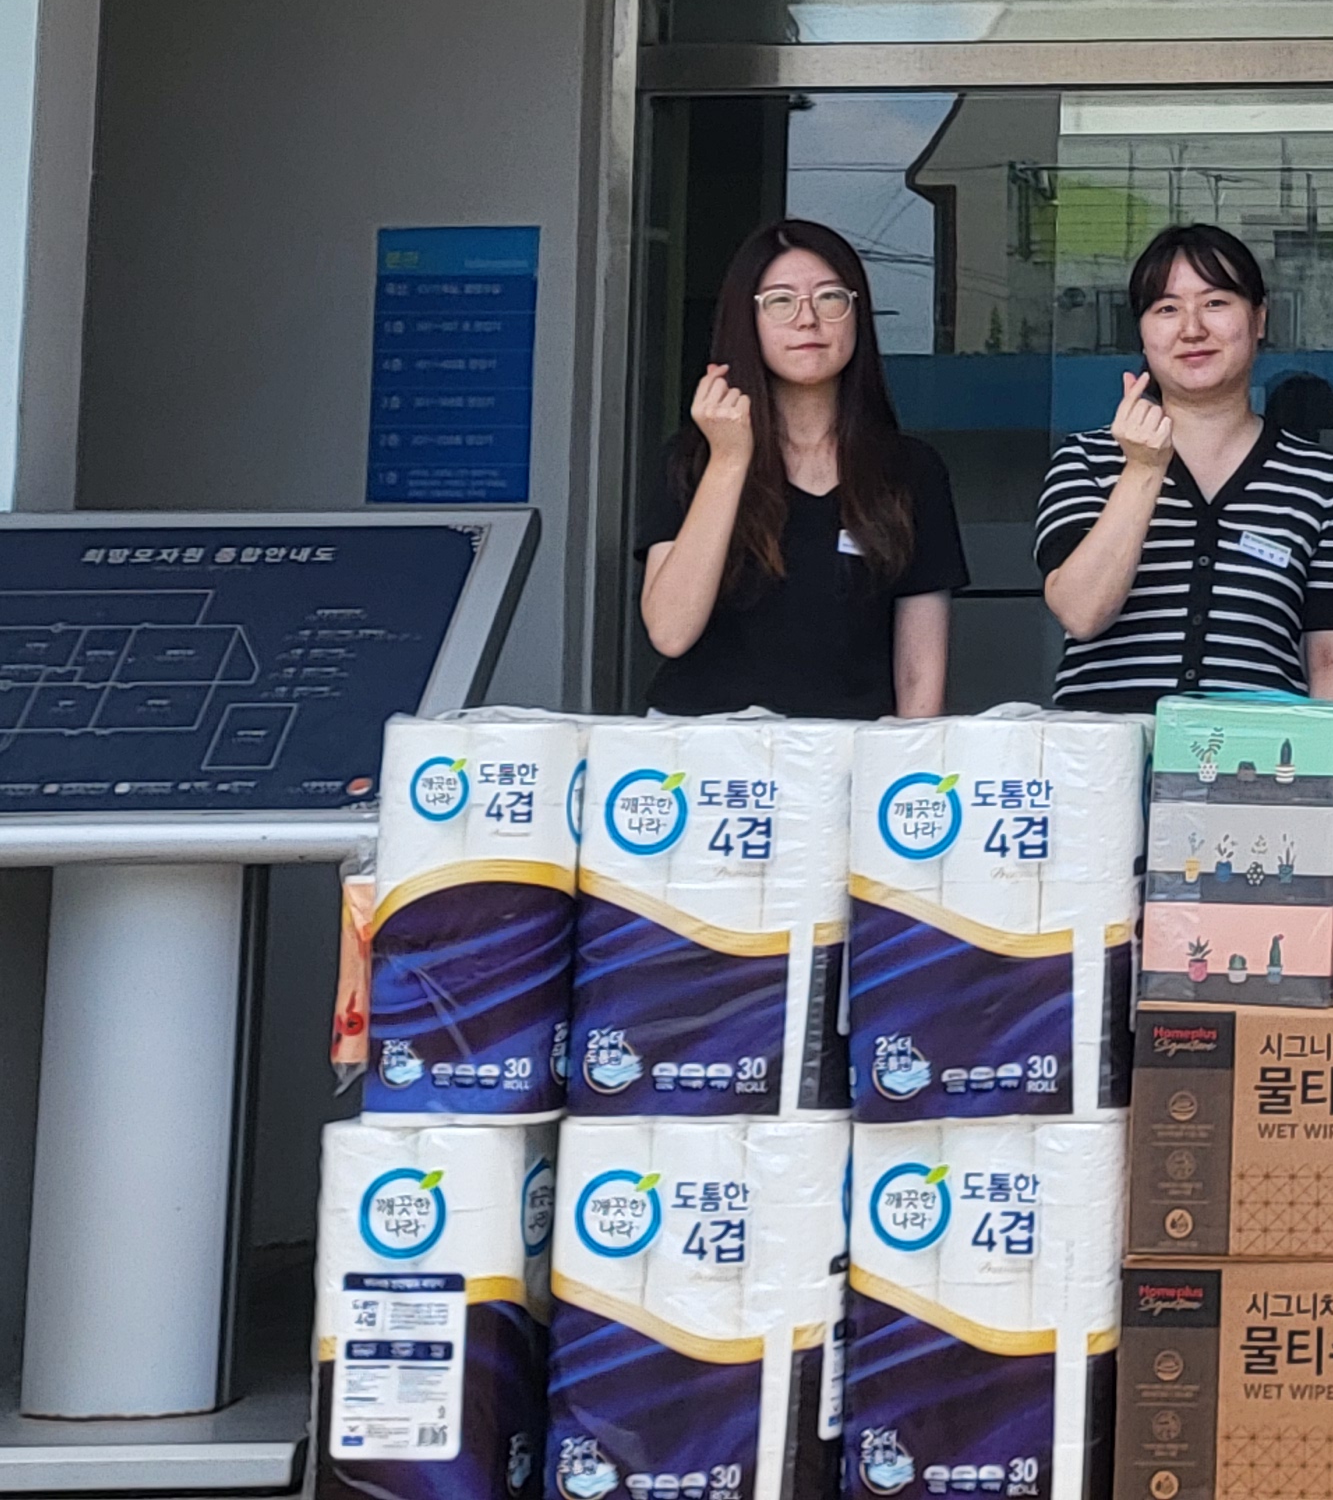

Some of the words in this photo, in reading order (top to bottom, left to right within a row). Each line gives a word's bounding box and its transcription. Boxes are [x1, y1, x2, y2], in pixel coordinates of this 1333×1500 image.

[478, 763, 539, 785] 도톰한
[697, 779, 779, 809] 도톰한
[971, 778, 1054, 810] 도톰한
[485, 791, 534, 824] 4겹
[621, 796, 673, 817] 깨끗한
[894, 798, 947, 819] 깨끗한
[628, 817, 663, 836] 나라
[903, 820, 938, 841] 나라
[708, 817, 773, 860] 4겹
[984, 816, 1049, 860] 4겹
[1153, 1027, 1217, 1041] Homeplus
[504, 1057, 531, 1078] 30
[736, 1056, 767, 1080] 30
[1026, 1054, 1058, 1079] 30
[1258, 1124, 1299, 1140] WET
[670, 1181, 750, 1211] 도톰한
[961, 1172, 1040, 1203] 도톰한
[376, 1195, 431, 1218] 깨끗한
[592, 1197, 647, 1219] 깨끗한
[885, 1190, 937, 1211] 깨끗한
[385, 1219, 421, 1238] 나라
[600, 1220, 634, 1239] 나라
[892, 1211, 928, 1230] 나라
[683, 1219, 746, 1264] 4겹
[971, 1210, 1036, 1256] 4겹
[1138, 1286, 1203, 1299] Homeplus
[1243, 1384, 1285, 1400] WET
[710, 1463, 741, 1489] 30
[1009, 1456, 1039, 1483] 30
